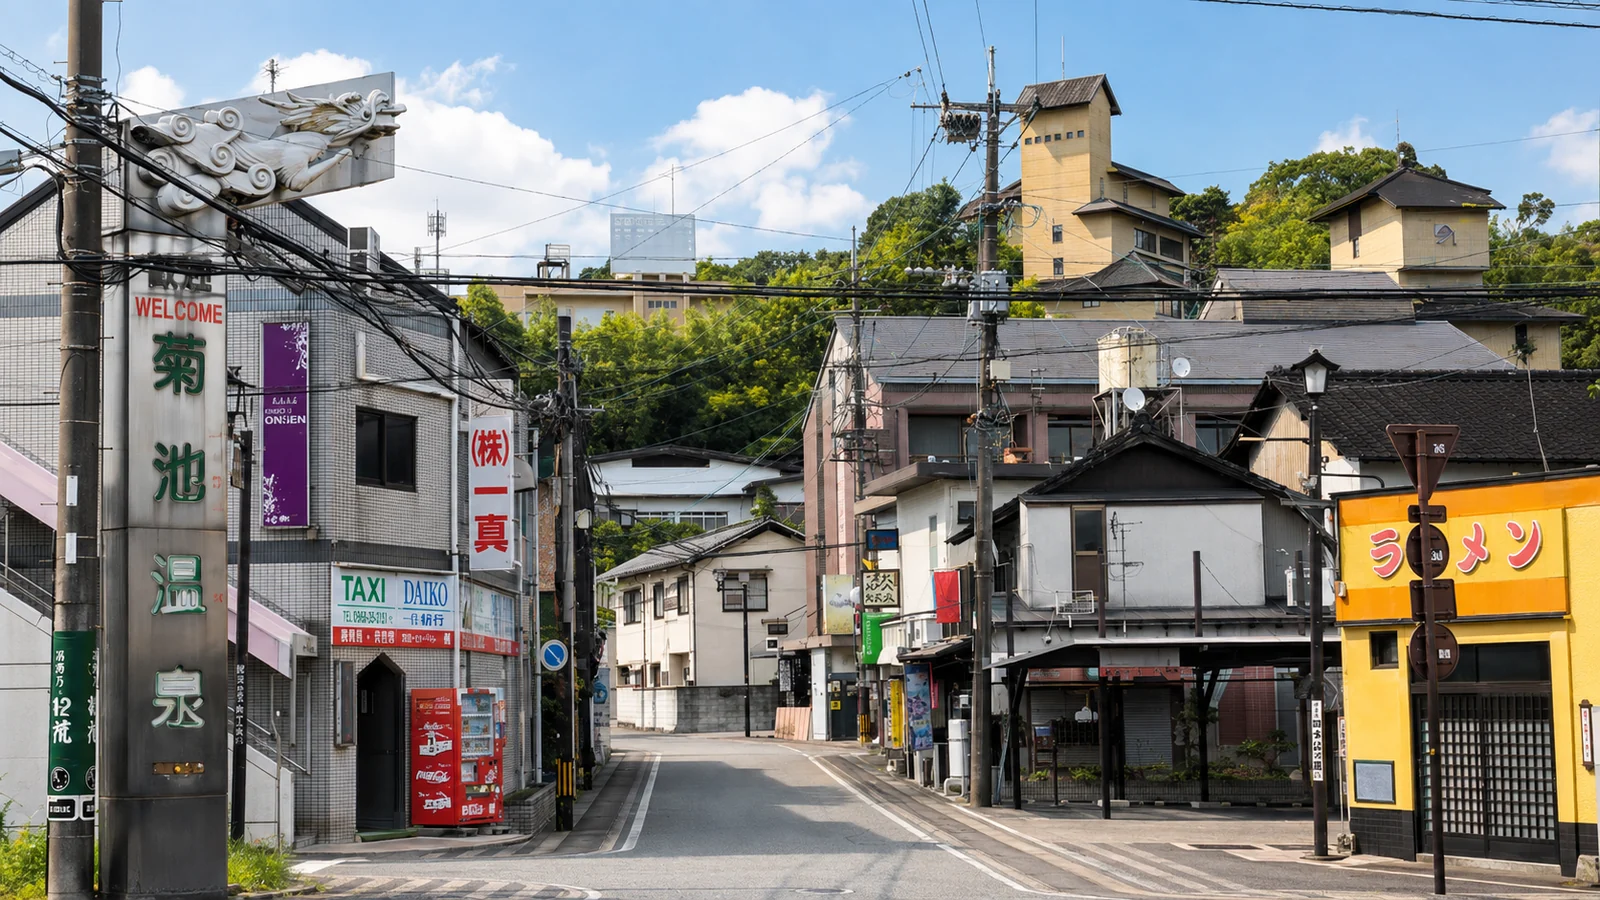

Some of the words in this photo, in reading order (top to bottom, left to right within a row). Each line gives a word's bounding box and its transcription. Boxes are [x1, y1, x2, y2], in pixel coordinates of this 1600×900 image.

[135, 296, 222, 324] WELCOME
[151, 331, 207, 728] 菊池温泉
[341, 575, 386, 603] TAXI
[403, 579, 448, 607] DAIKO
